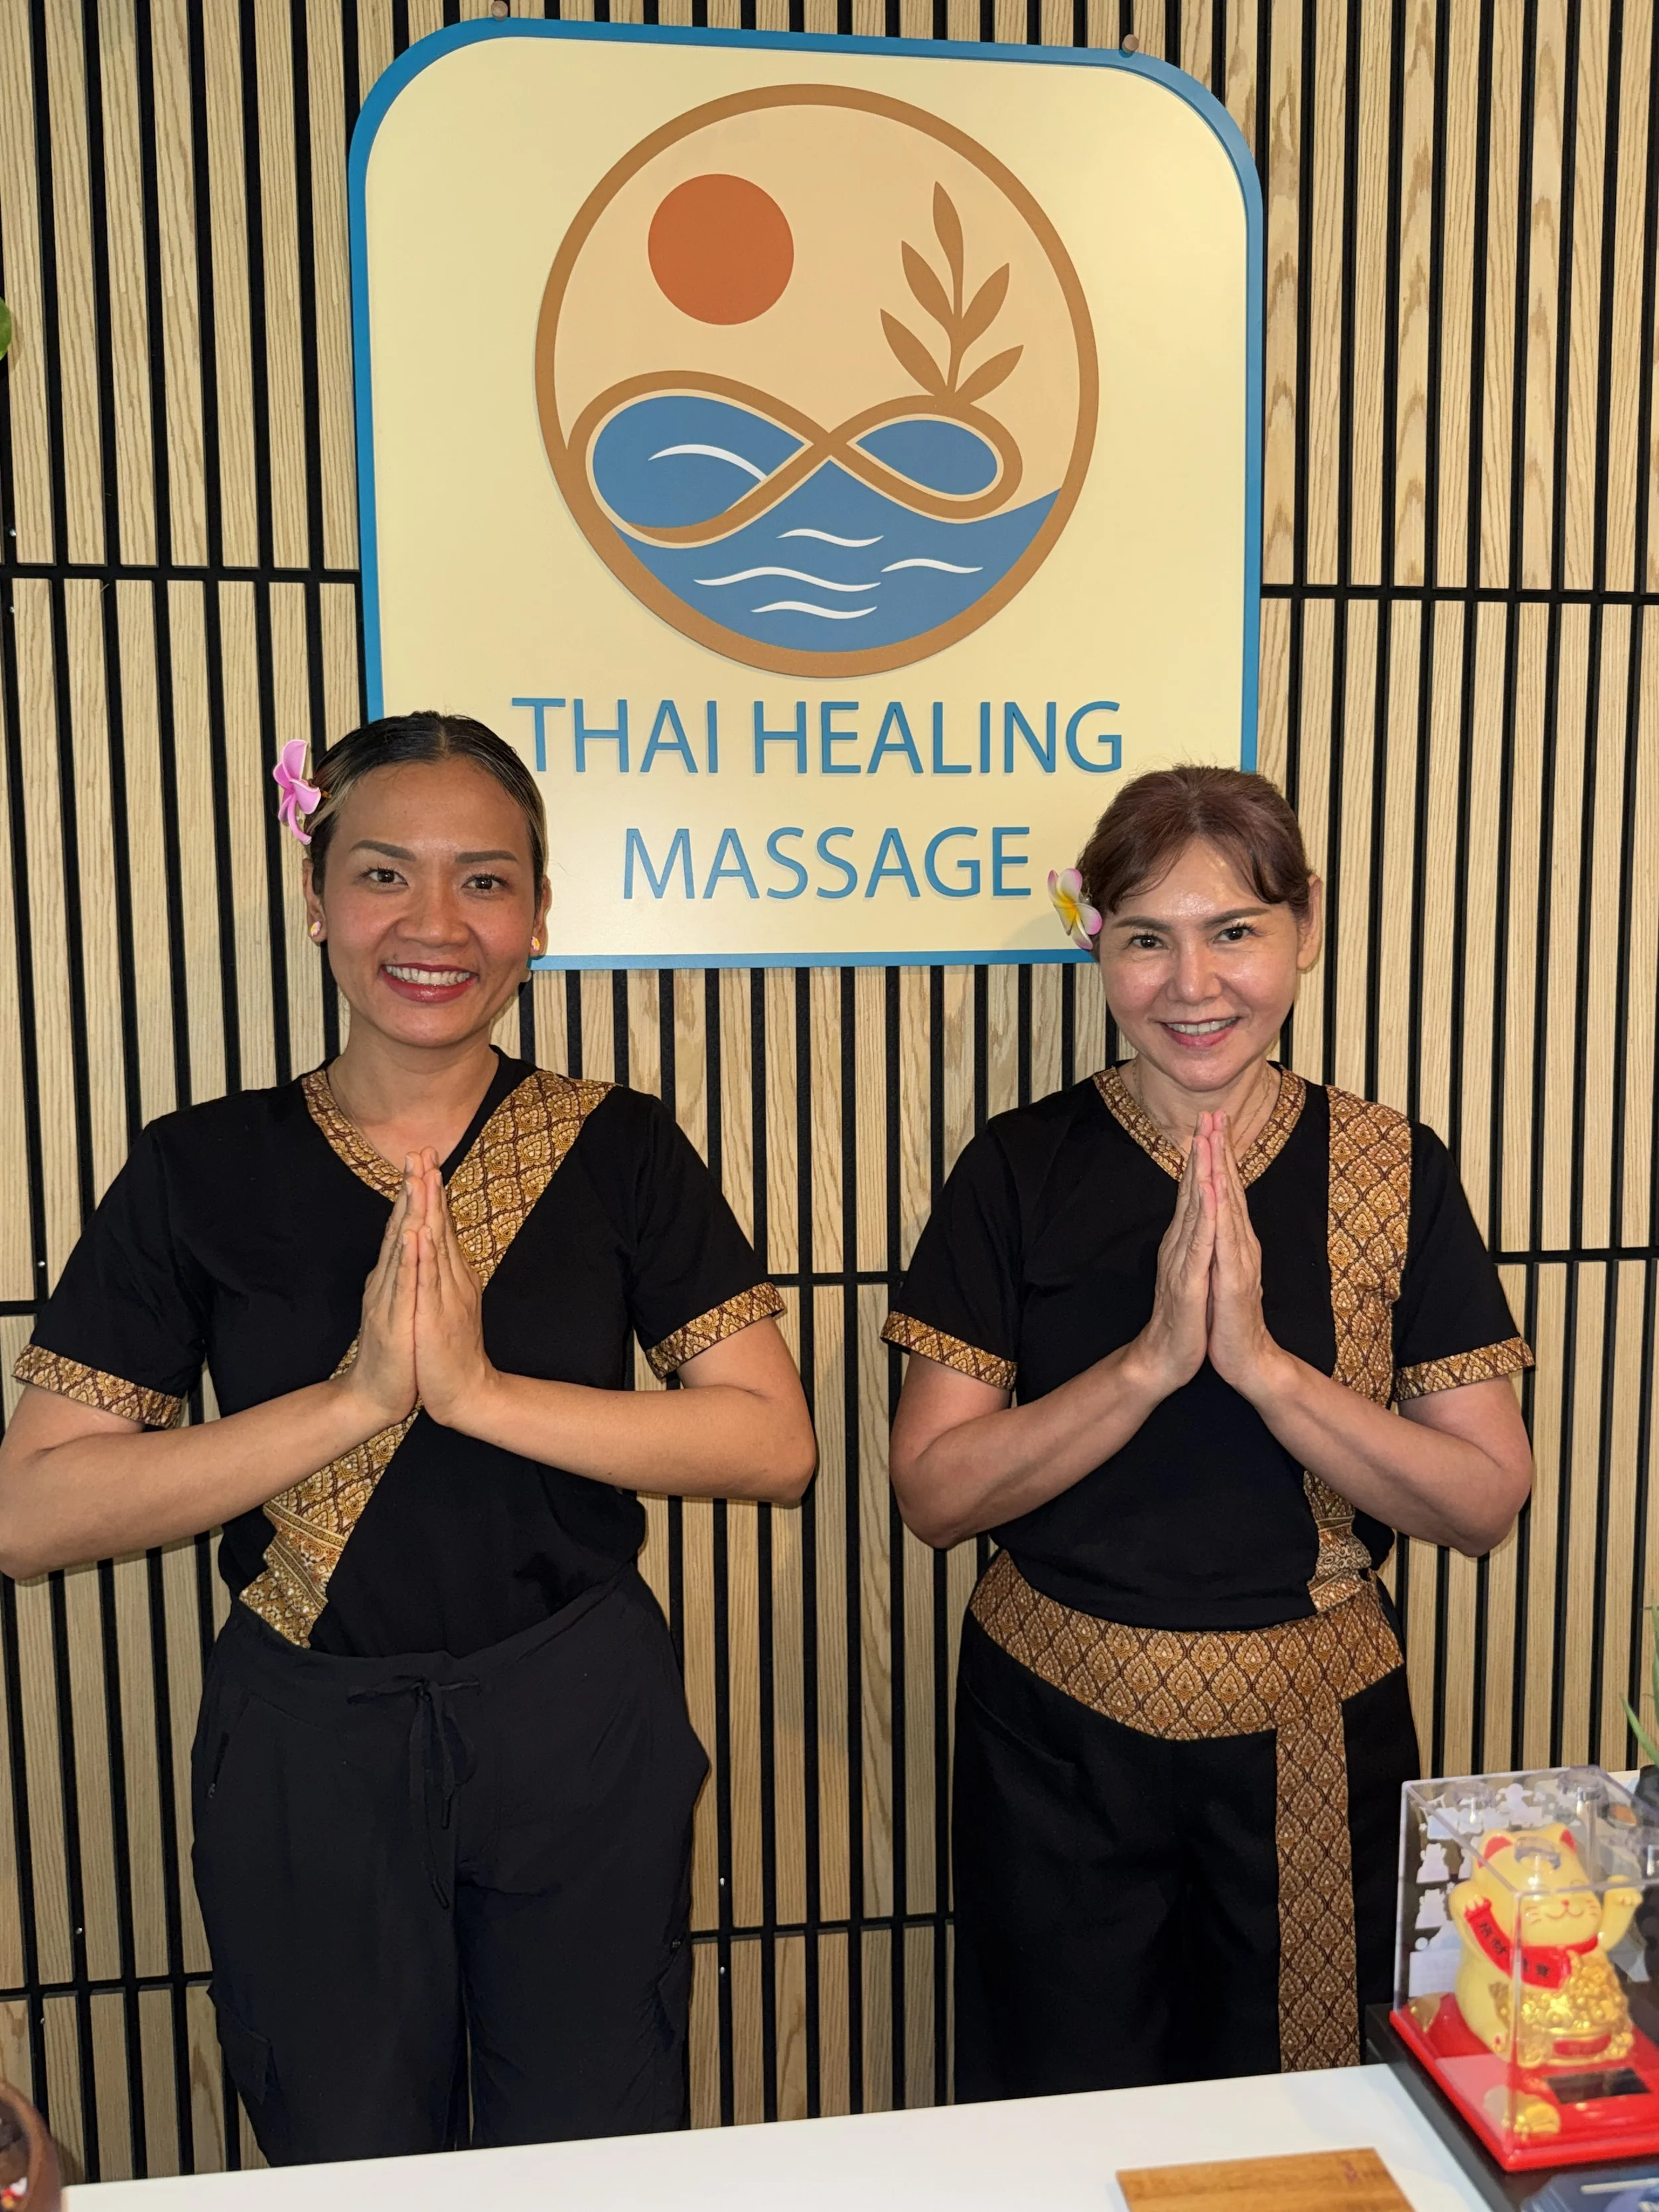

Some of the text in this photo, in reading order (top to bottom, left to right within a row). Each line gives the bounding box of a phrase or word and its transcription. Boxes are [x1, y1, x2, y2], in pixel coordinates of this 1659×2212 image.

[512, 698, 1122, 773] THAI HEALING
[623, 826, 1031, 899] MASSAGE
